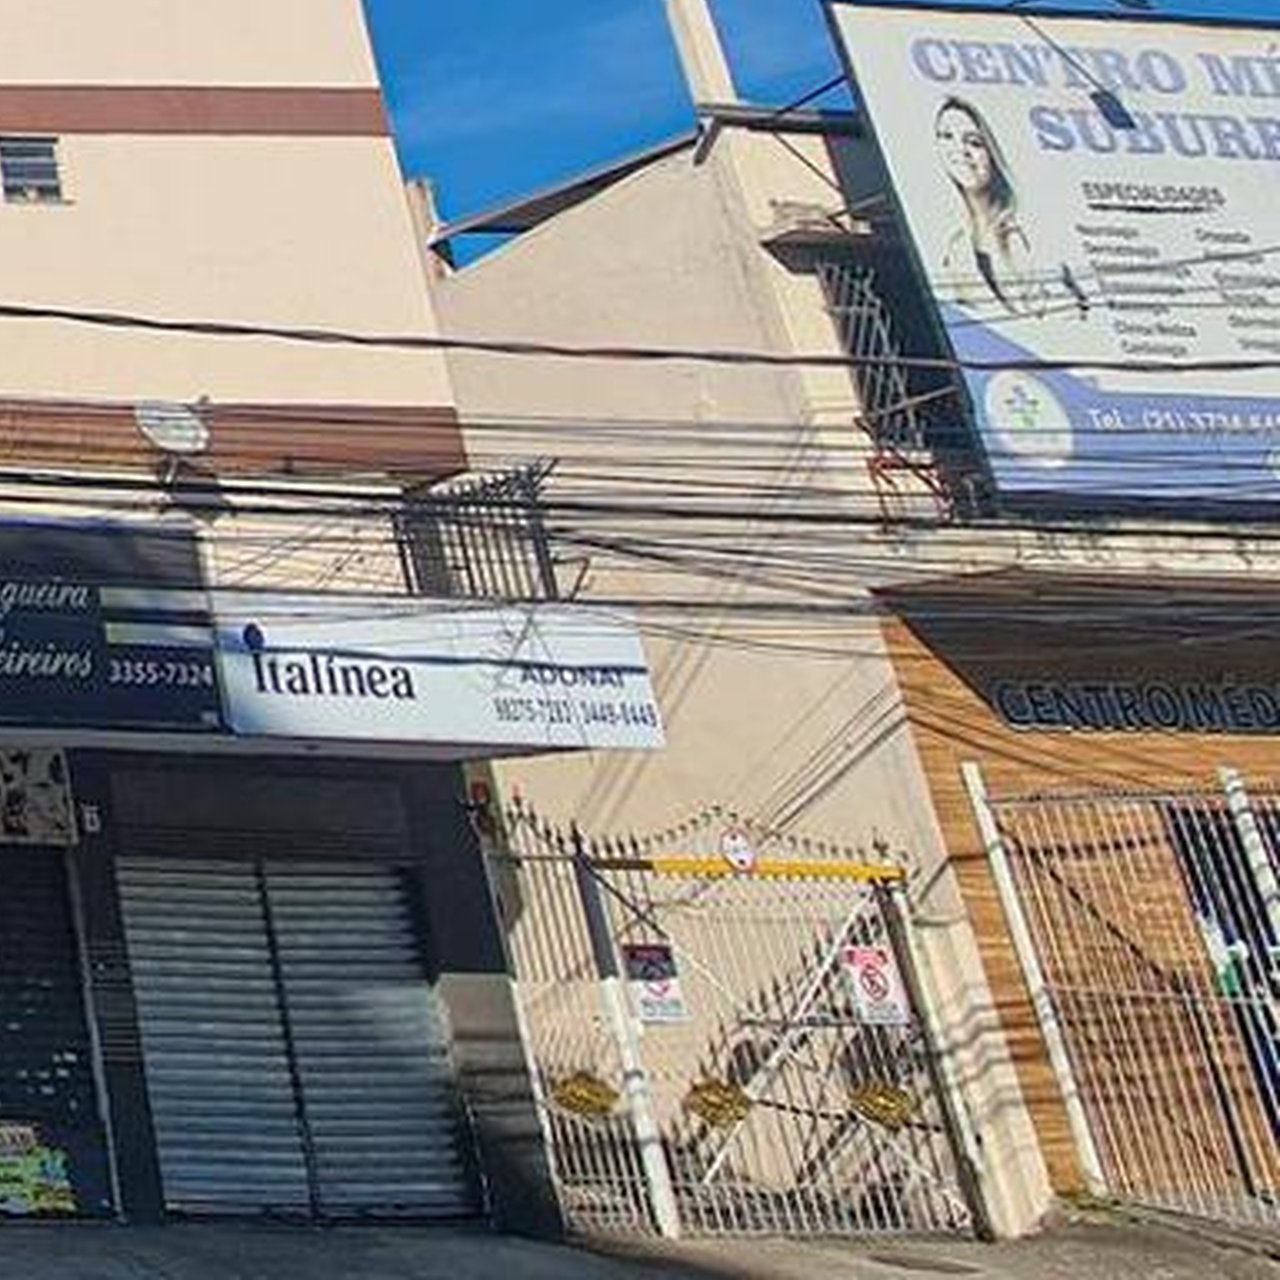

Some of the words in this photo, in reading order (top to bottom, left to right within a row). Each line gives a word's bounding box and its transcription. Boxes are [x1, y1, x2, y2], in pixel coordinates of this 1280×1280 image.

[910, 38, 1186, 94] CENTRO
[248, 650, 416, 700] Italínea
[997, 681, 1180, 731] CENTRO
